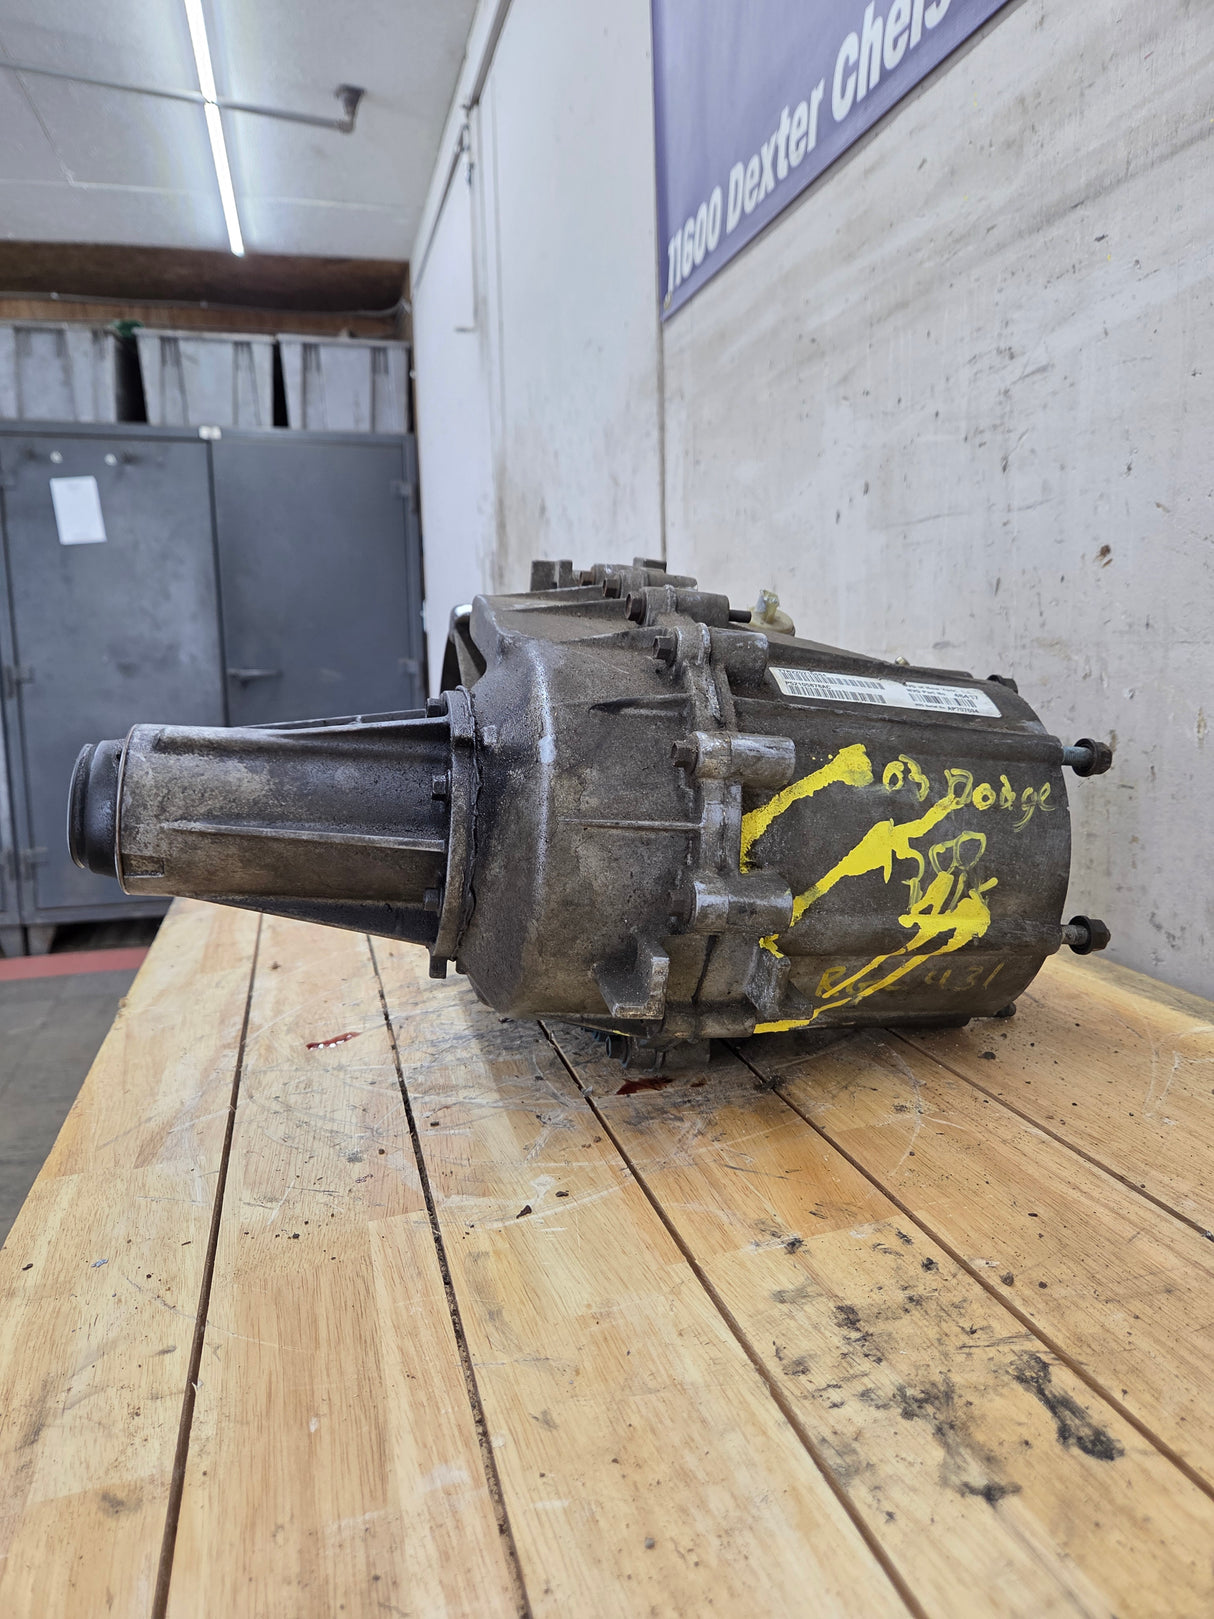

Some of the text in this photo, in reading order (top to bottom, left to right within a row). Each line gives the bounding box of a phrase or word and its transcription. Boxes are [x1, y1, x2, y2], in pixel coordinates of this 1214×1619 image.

[668, 186, 723, 291] 11600
[726, 77, 825, 234] Dexter
[943, 768, 1056, 832] Dodge
